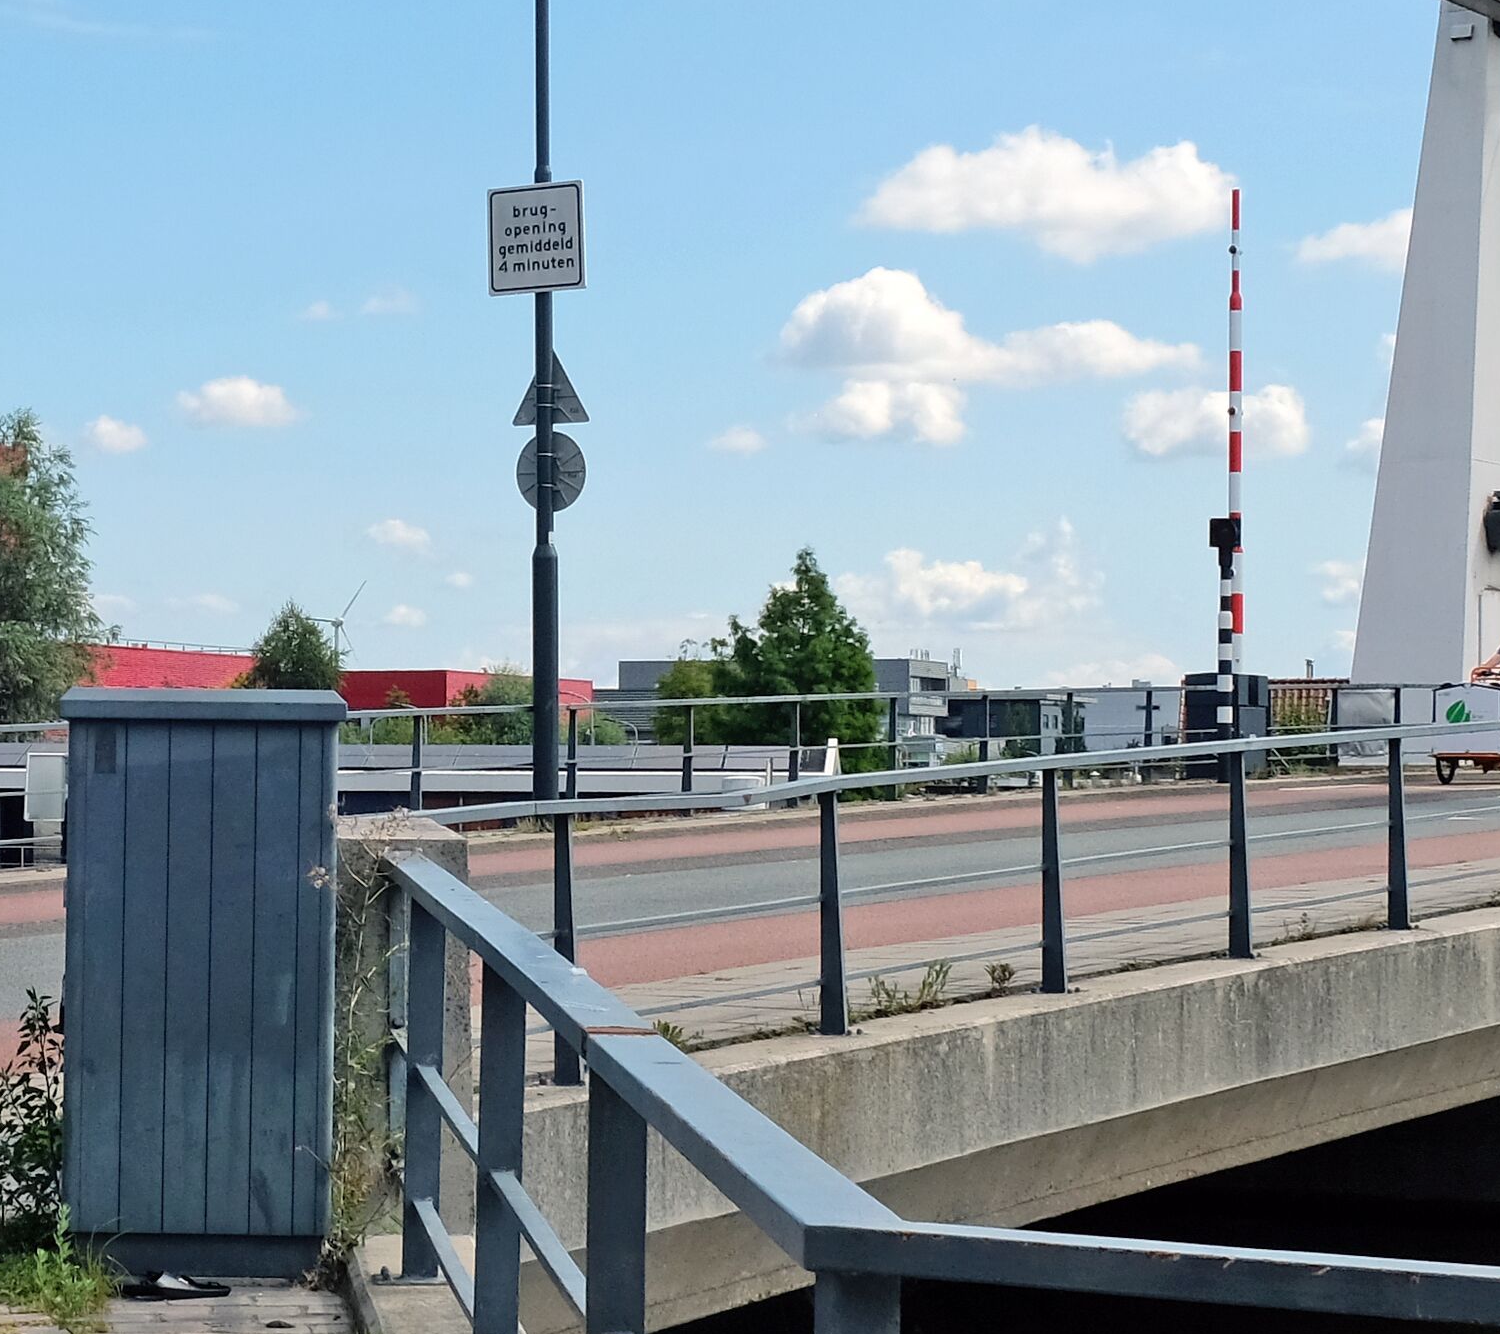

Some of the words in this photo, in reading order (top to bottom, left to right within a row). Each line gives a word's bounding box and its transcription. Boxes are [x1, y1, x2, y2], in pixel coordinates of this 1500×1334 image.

[512, 205, 556, 219] brug-
[504, 221, 566, 238] opening
[498, 236, 573, 259] gemiddeld
[498, 260, 508, 272] 4
[513, 256, 574, 272] minuten
